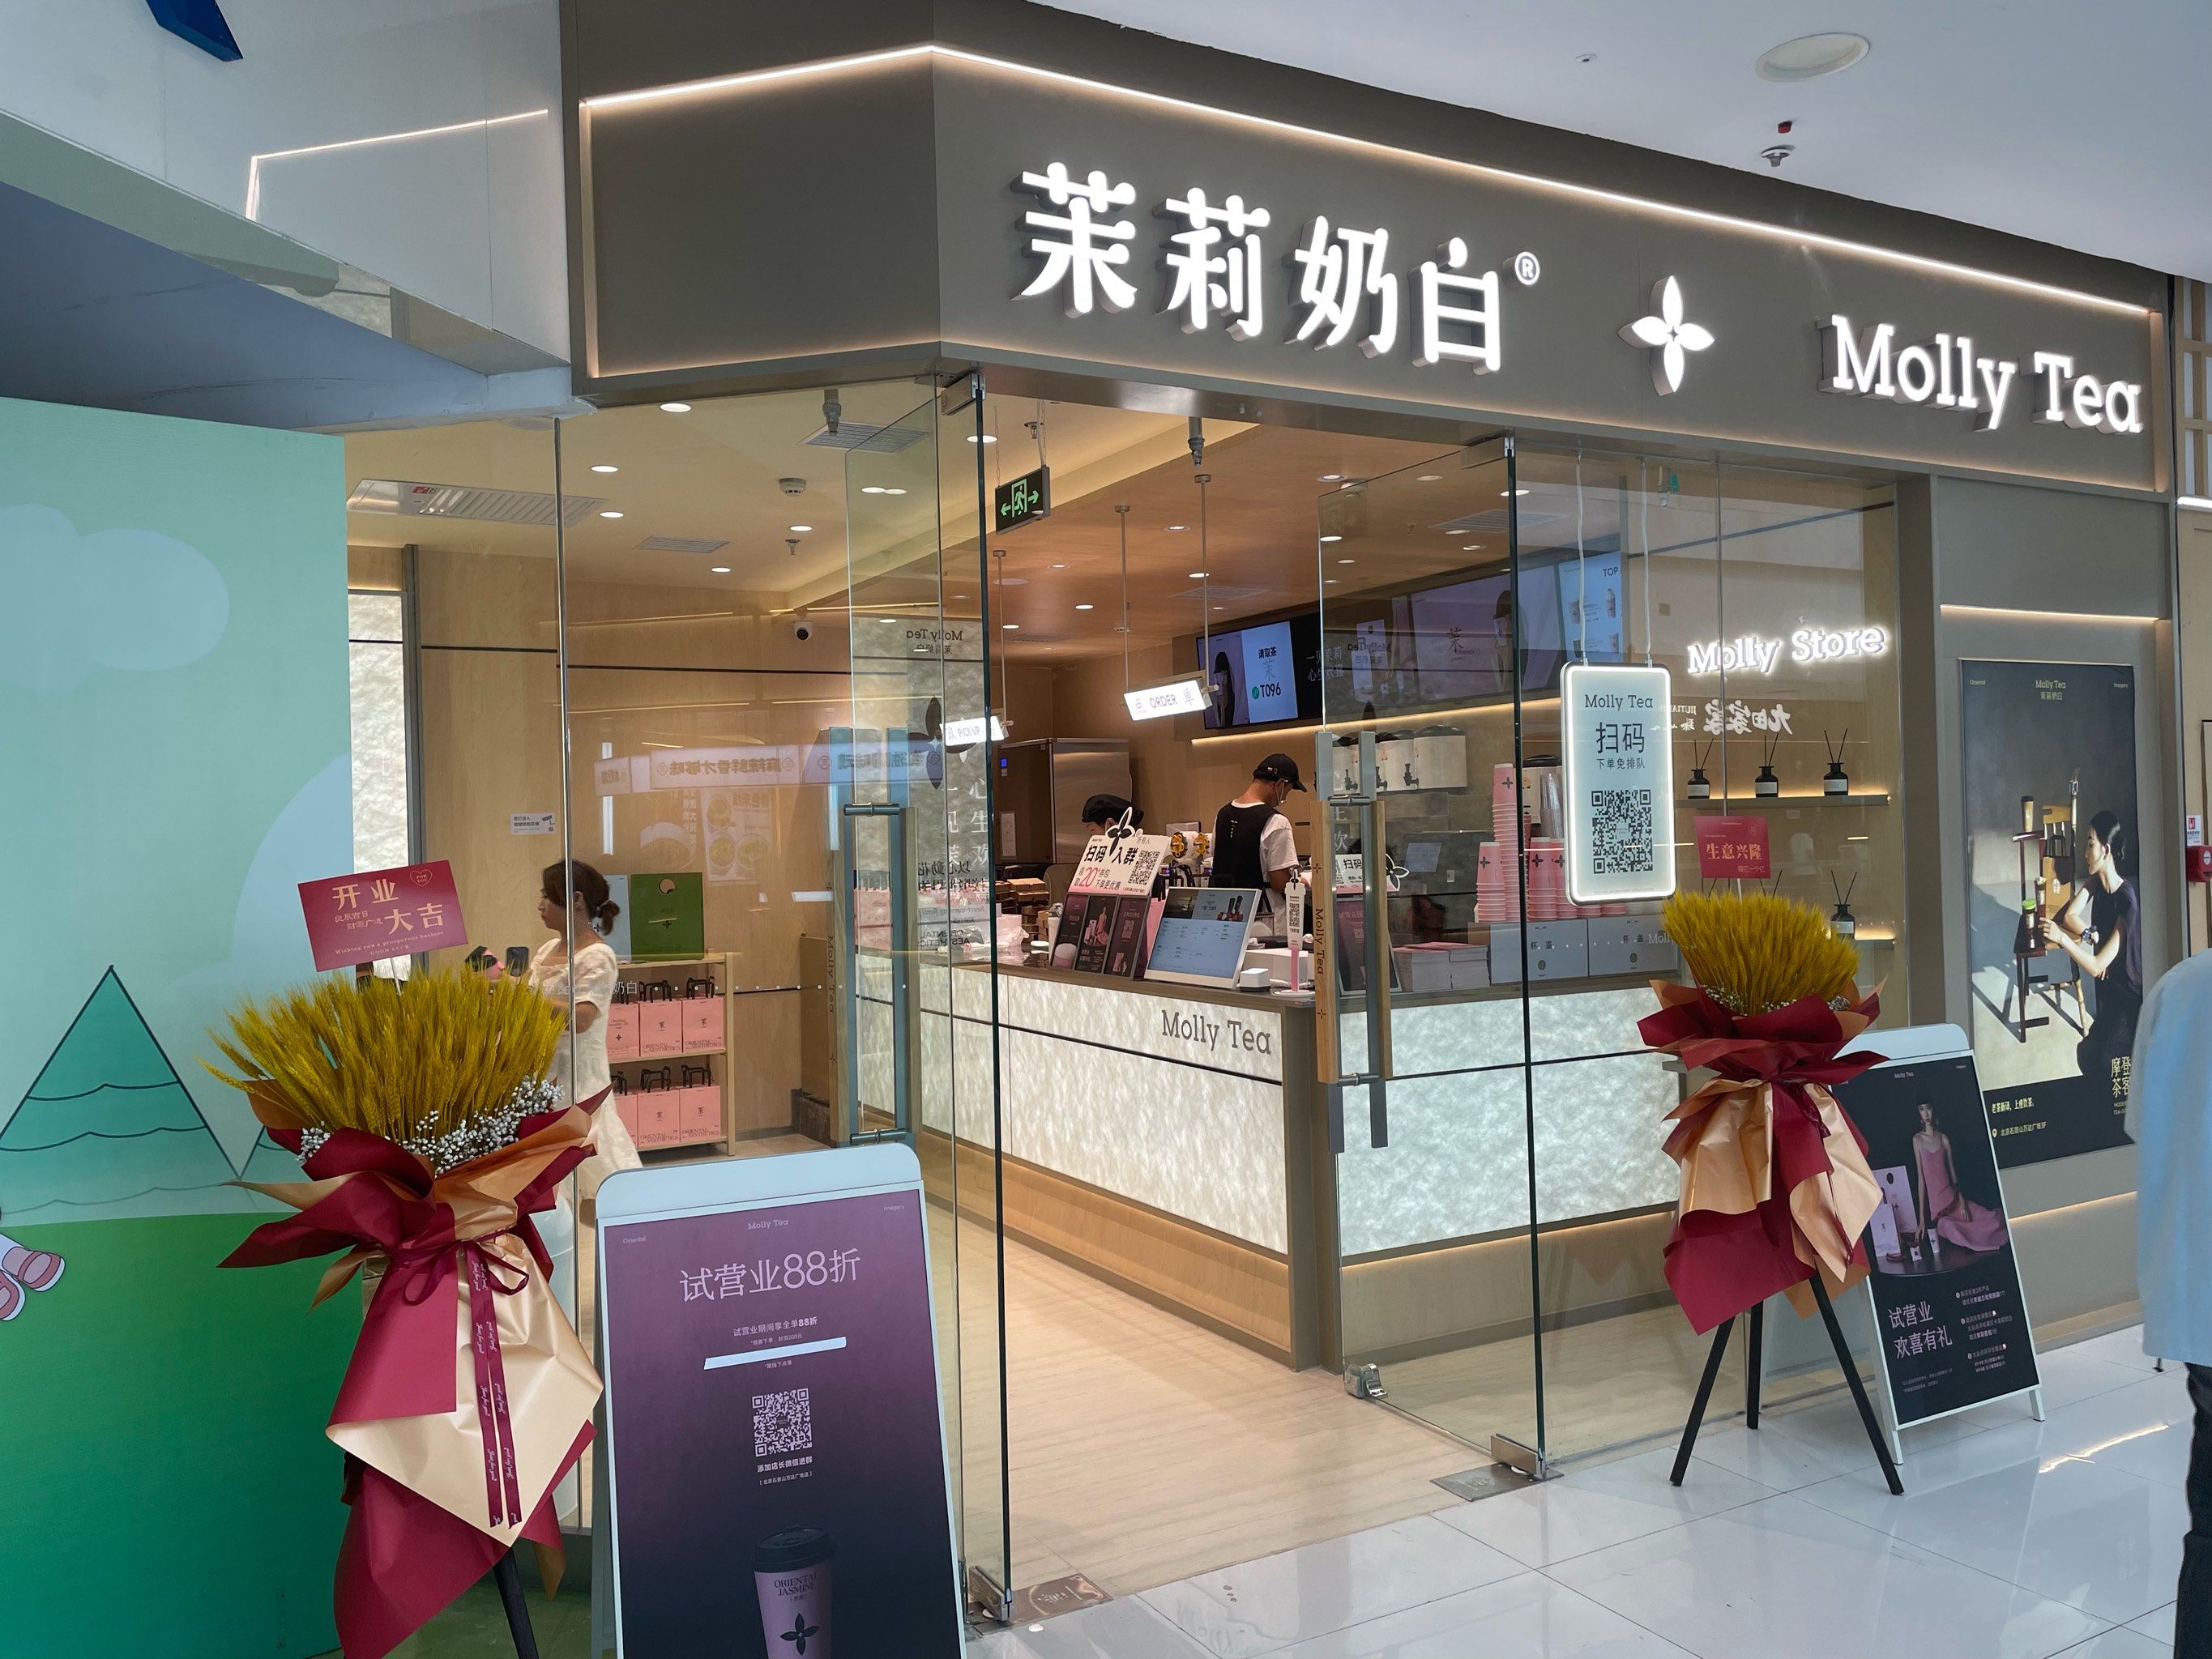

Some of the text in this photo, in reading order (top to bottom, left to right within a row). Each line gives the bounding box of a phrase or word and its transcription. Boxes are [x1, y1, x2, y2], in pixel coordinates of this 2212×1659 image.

[1021, 162, 1501, 373] 茉莉奶白
[1832, 314, 2143, 434] Molly Tea
[1688, 628, 1886, 673] Molly Store
[1259, 682, 1282, 698] T096
[2035, 680, 2065, 689] Molly Tea
[1149, 693, 1178, 708] ORDER
[1585, 694, 1653, 711] Molly Tea
[1595, 722, 1645, 754] 扫码
[1596, 757, 1645, 770] 下单免排队
[1706, 843, 1761, 859] 生意兴隆
[332, 878, 399, 911] 开业
[384, 902, 443, 935] 大吉
[1313, 908, 1326, 975] Molly Tea
[1162, 1009, 1271, 1055] Molly Tea
[2111, 1056, 2131, 1078] 摩登
[747, 1218, 788, 1230] Molly Tea
[679, 1247, 861, 1303] 试营业88折
[733, 1316, 818, 1337] 试营业期间享全单88折
[1888, 1300, 1933, 1329] 试营业
[1894, 1324, 1953, 1359] 欢喜有礼
